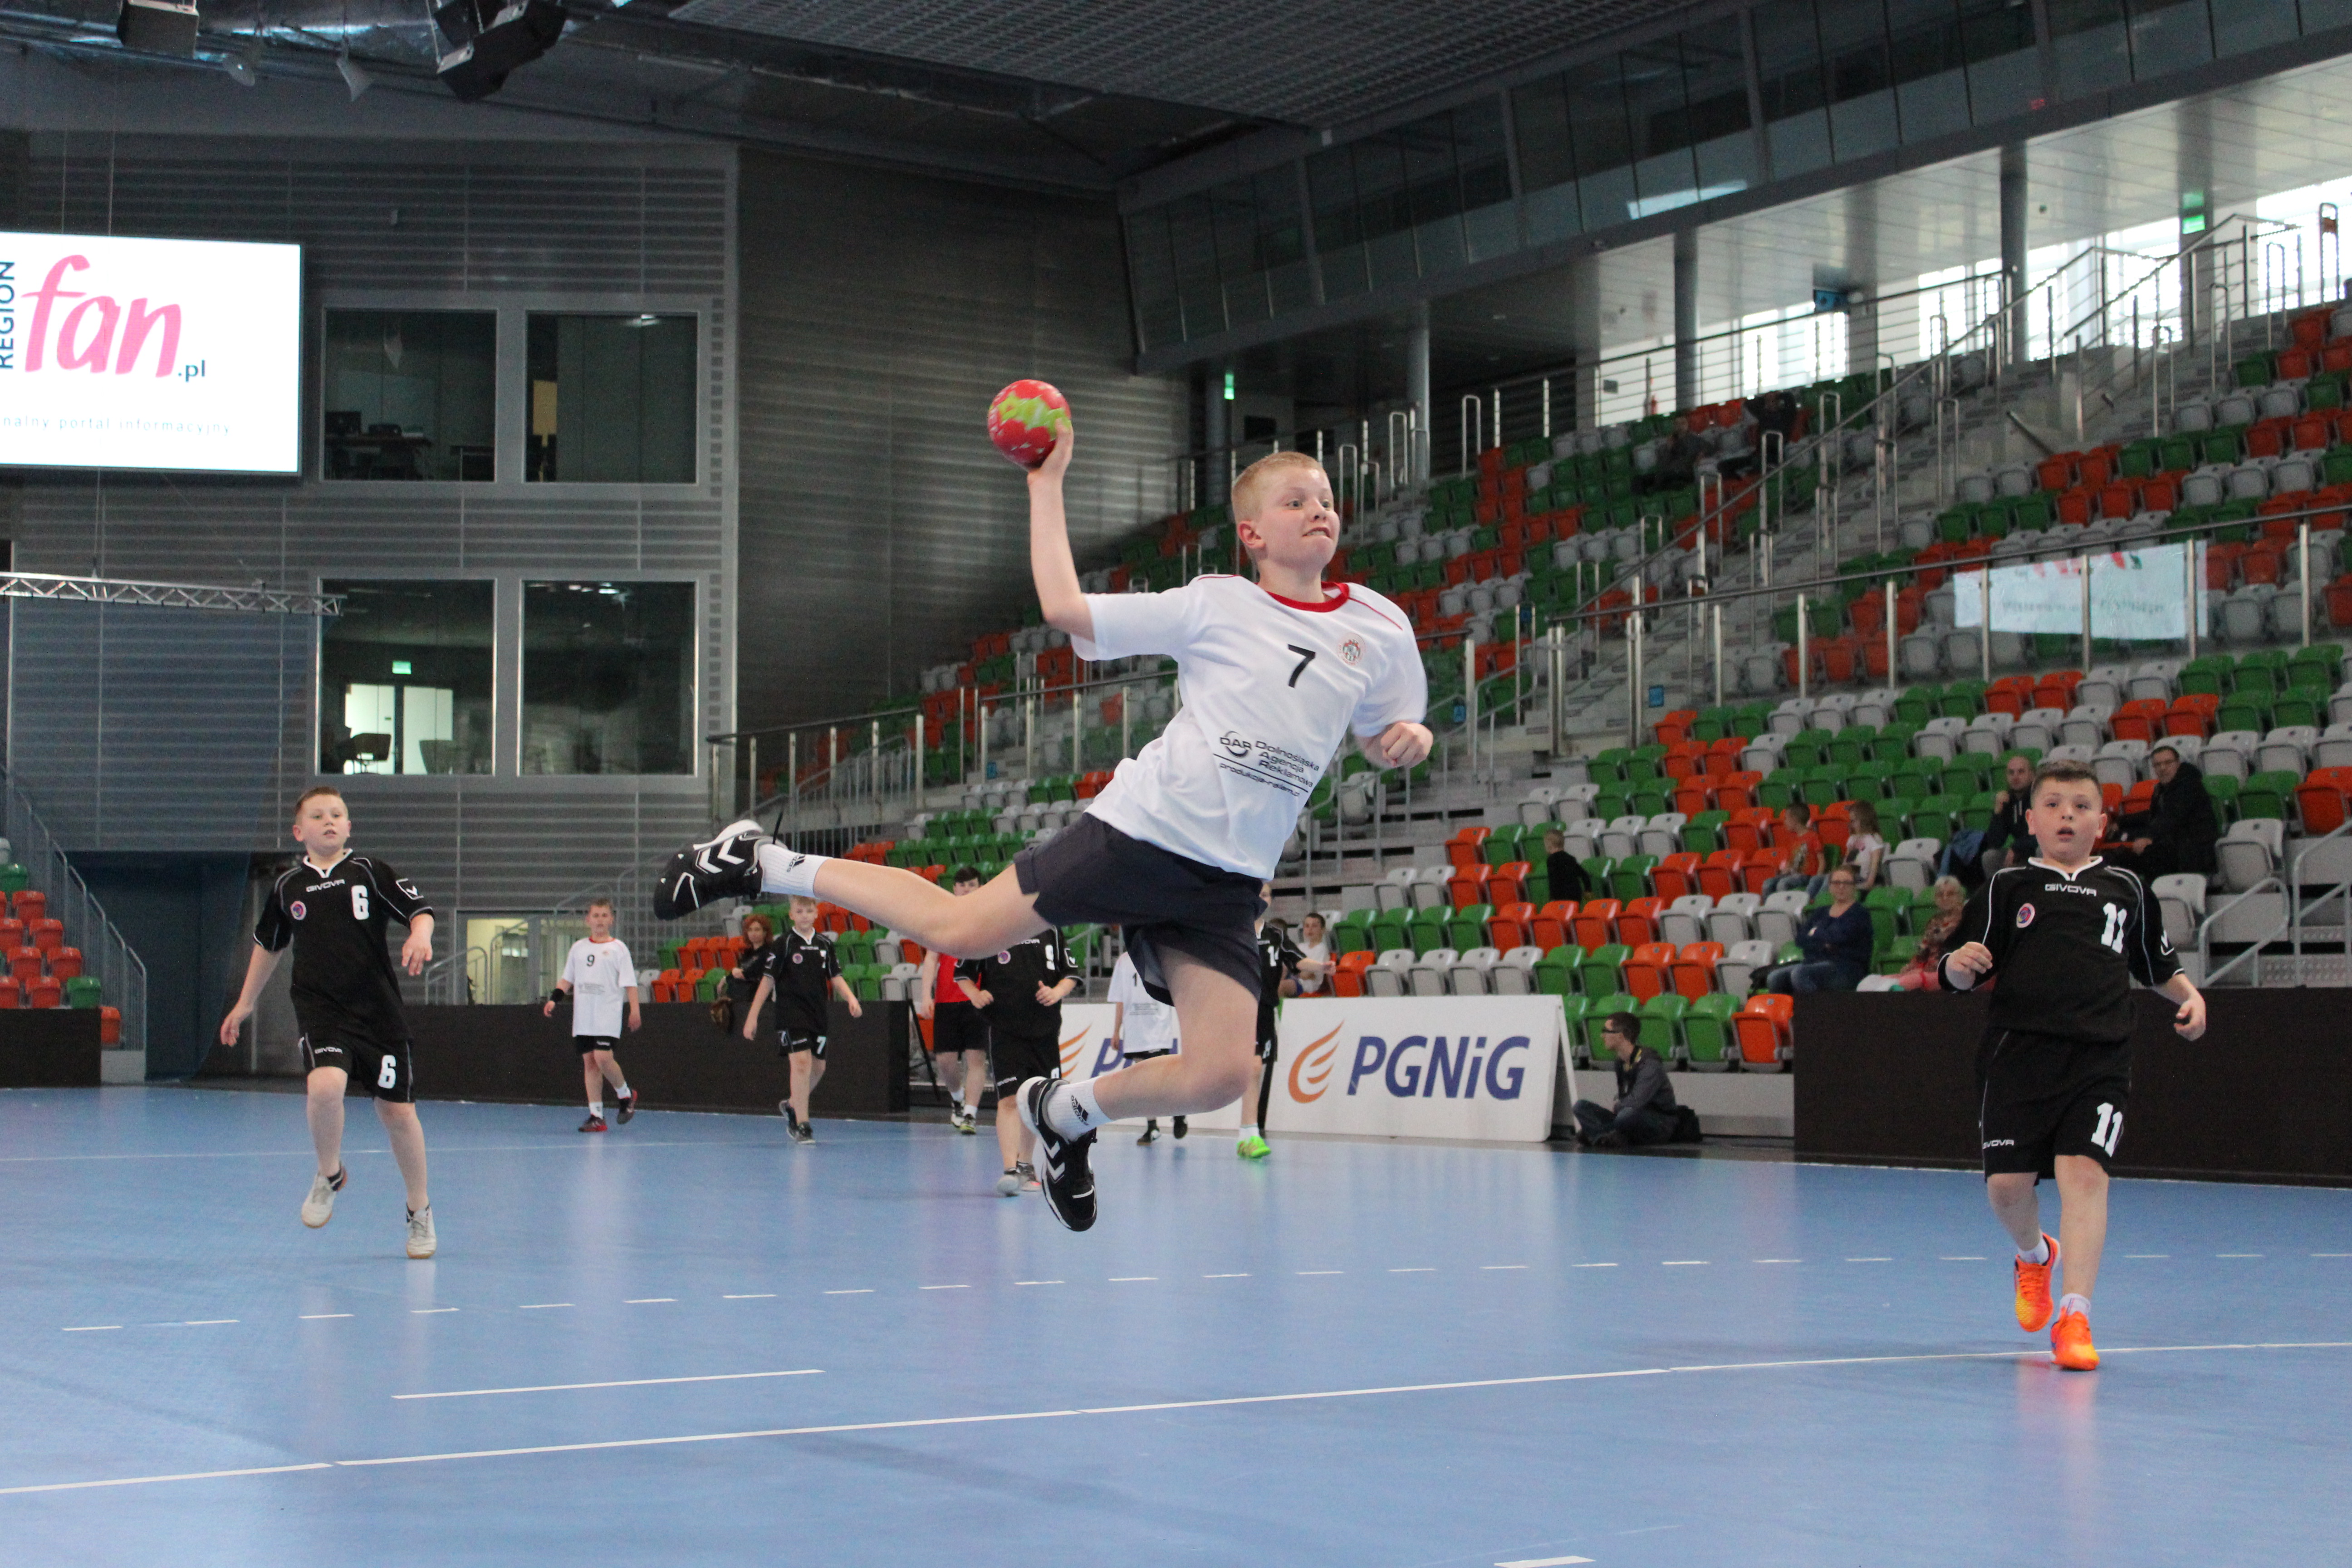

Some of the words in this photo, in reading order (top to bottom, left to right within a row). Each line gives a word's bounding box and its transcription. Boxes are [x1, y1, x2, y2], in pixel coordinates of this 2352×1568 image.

[0, 261, 15, 370] REGION
[59, 417, 110, 431] portal
[119, 418, 230, 436] informacyjny
[1288, 644, 1316, 689] 7
[1220, 737, 1252, 750] DAR
[1259, 751, 1304, 773] Agencja
[1259, 760, 1313, 788] Reklamowa
[306, 879, 345, 892] GIVOVA
[2044, 883, 2097, 897] GIVOVA
[351, 885, 370, 920] 6
[2101, 902, 2127, 954] 11
[586, 954, 595, 967] 9
[817, 1035, 827, 1054] 7
[377, 1054, 397, 1089] 6
[1347, 1035, 1531, 1101] PGNiG
[2090, 1102, 2123, 1157] 11
